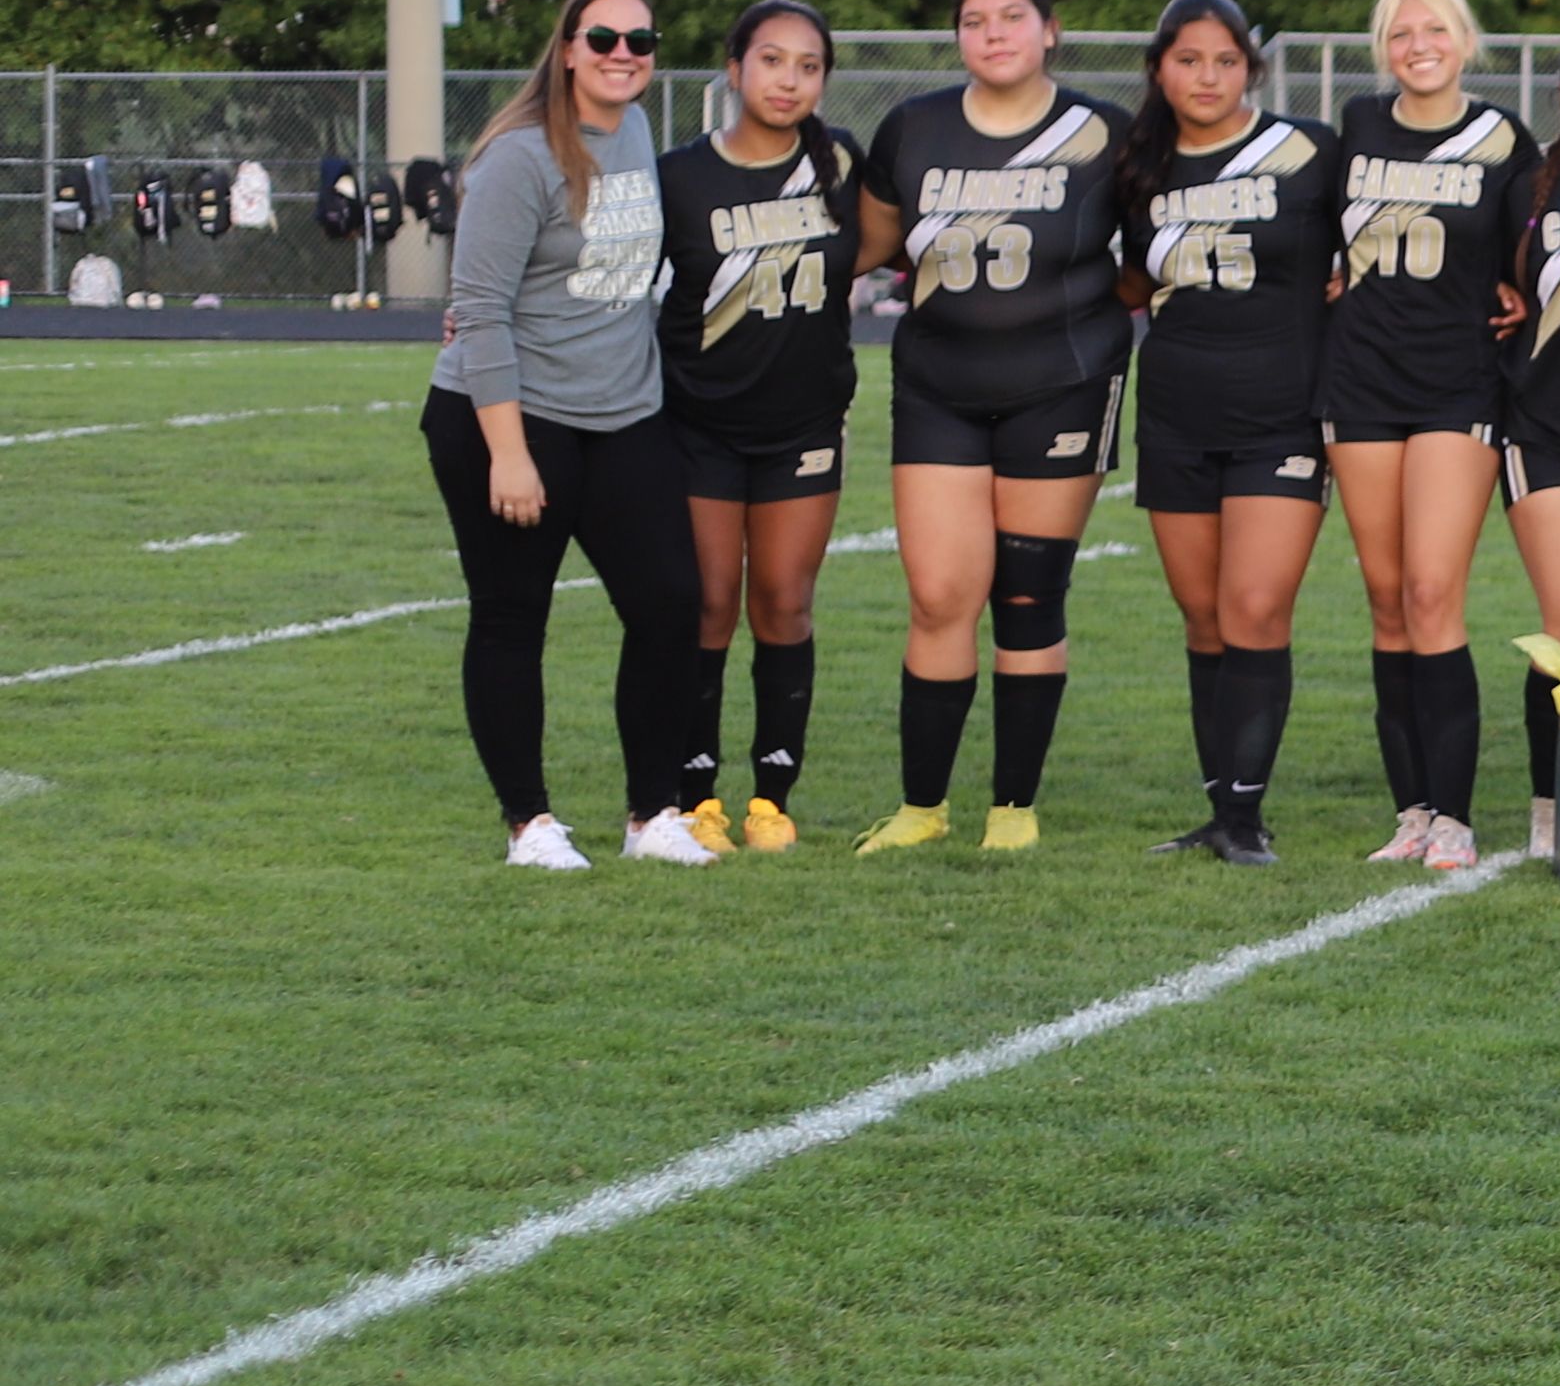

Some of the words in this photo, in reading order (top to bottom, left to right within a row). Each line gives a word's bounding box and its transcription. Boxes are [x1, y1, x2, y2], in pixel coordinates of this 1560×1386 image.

[918, 165, 1069, 214] CANNERS
[1149, 174, 1278, 229] CANNERS
[1346, 154, 1484, 208] CANNERS
[934, 222, 1033, 294] 33
[1174, 233, 1257, 292] 45
[1367, 215, 1446, 281] 10
[749, 250, 826, 319] 44
